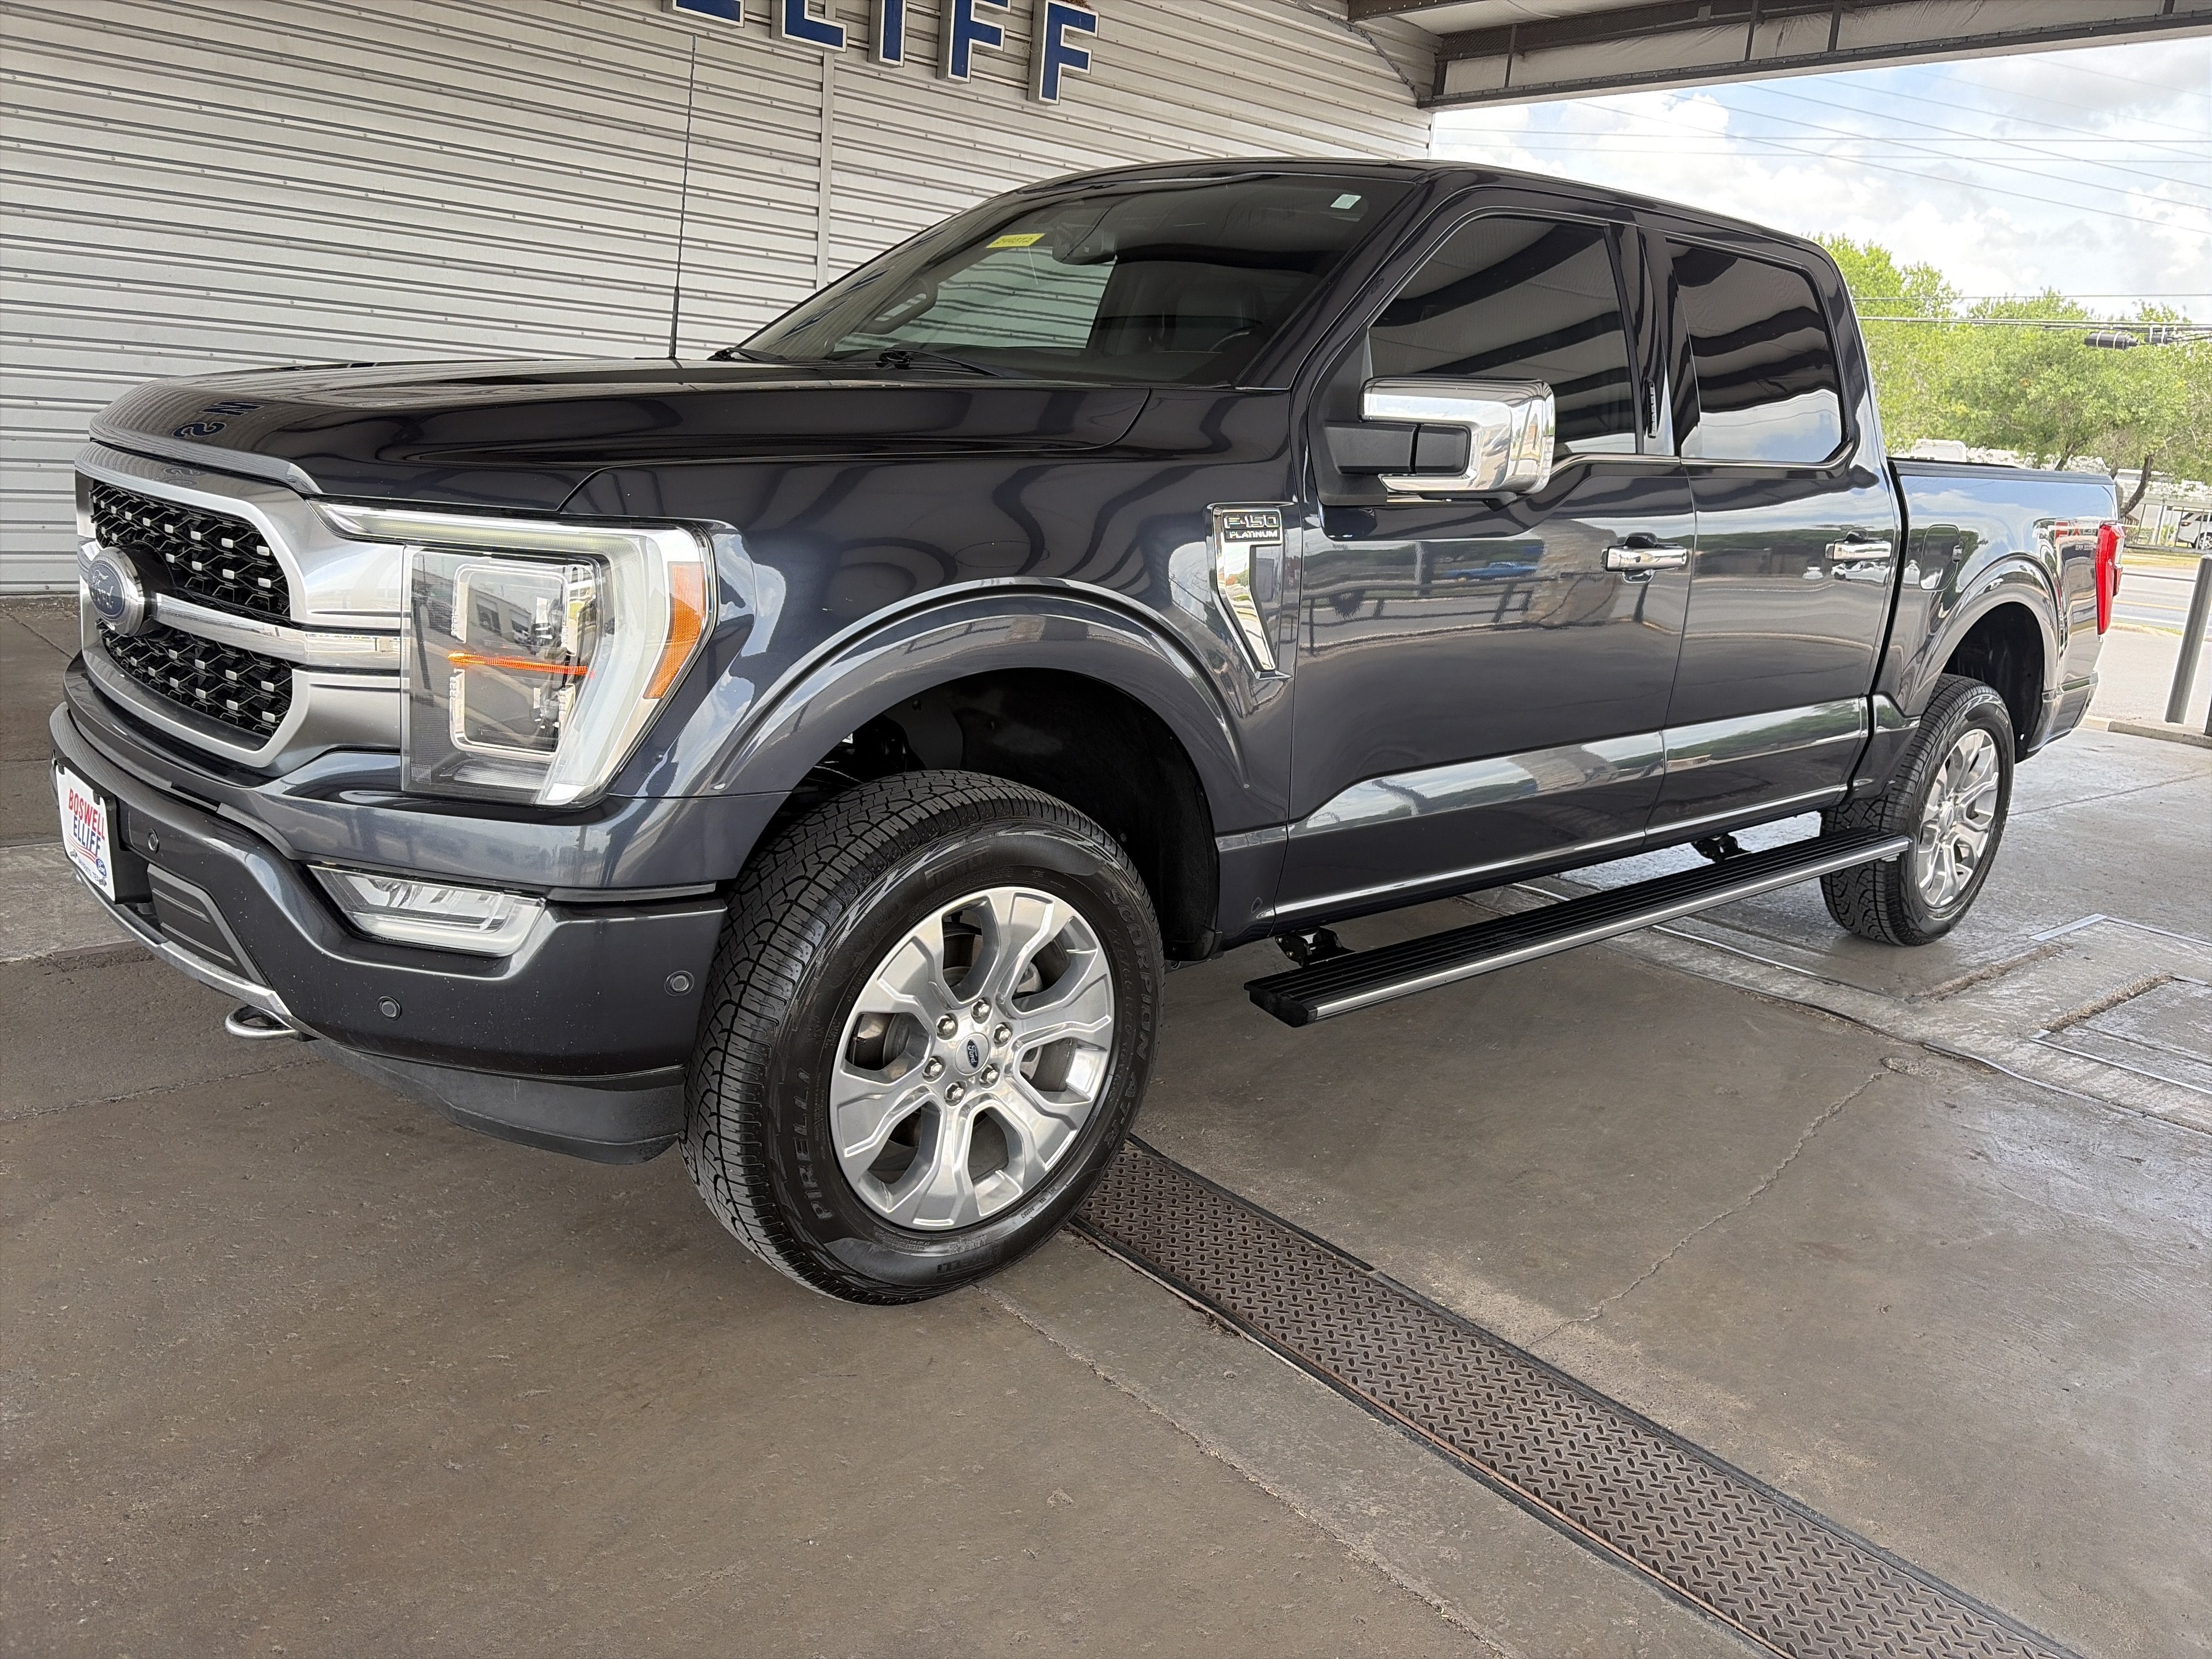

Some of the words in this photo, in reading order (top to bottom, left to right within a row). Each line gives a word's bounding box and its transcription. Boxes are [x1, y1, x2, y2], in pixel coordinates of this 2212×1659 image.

[672, 0, 1099, 105] LIFF
[1224, 515, 1279, 529] F-150
[1229, 530, 1278, 539] PLATINUM
[68, 788, 105, 841] BOSWELL
[73, 815, 101, 857] ELLIFF
[1104, 886, 1152, 1060] SCORPION
[793, 1067, 834, 1220] PIRELLI
